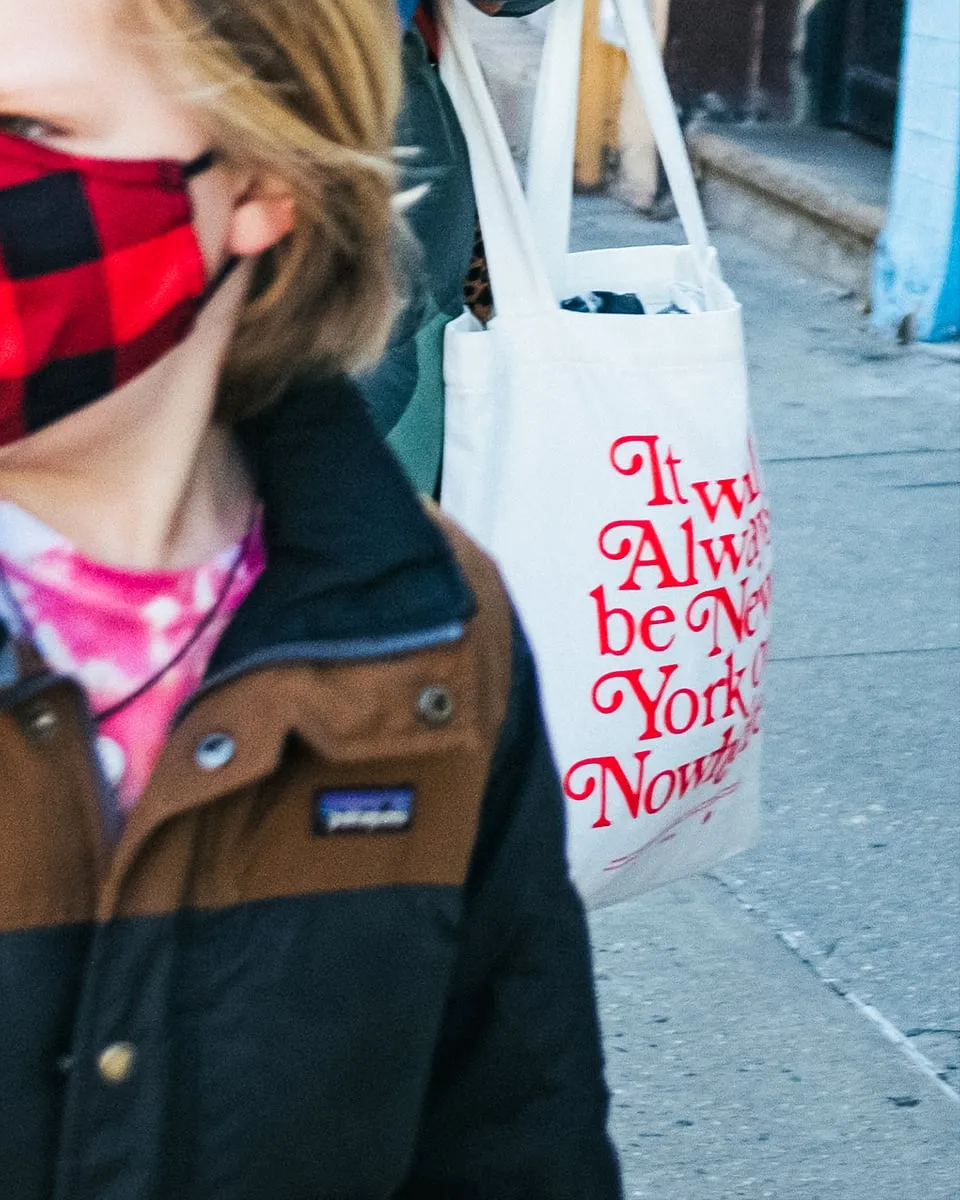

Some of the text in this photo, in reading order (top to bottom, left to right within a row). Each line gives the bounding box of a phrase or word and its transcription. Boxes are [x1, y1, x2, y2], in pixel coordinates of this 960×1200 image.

[610, 435, 688, 506] It
[589, 584, 676, 657] be
[591, 653, 749, 741] York
